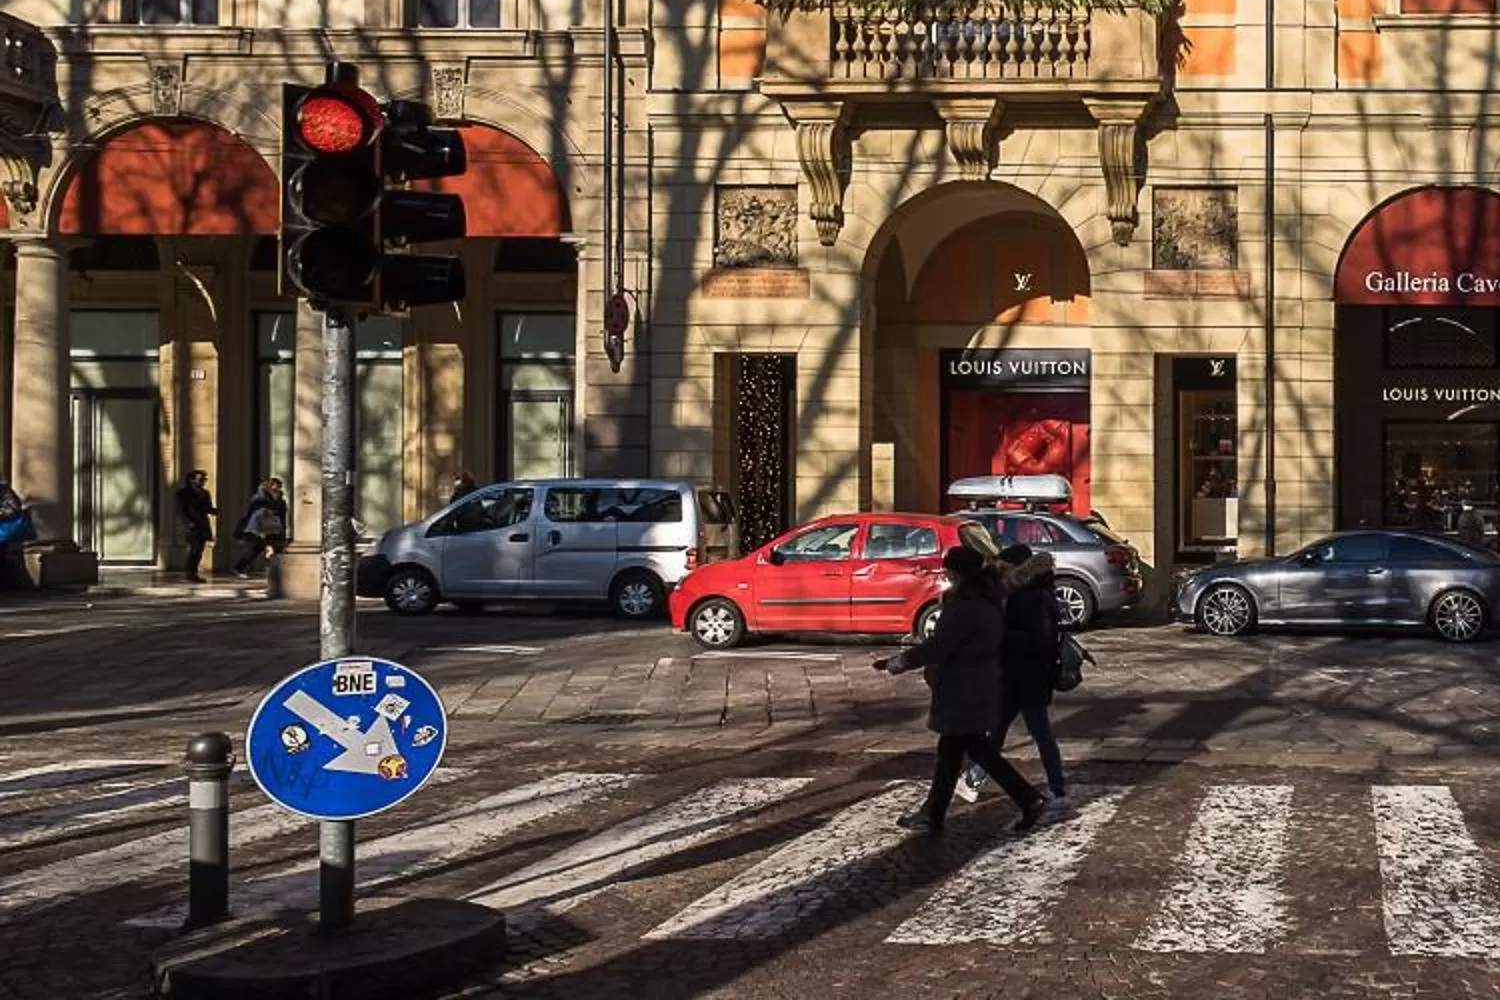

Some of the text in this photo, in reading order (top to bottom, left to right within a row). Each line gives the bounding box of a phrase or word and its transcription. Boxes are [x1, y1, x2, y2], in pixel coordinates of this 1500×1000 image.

[1365, 271, 1450, 293] Galleria
[950, 360, 1086, 375] LOUIS VUITTON
[1383, 387, 1428, 401] LOUIS
[336, 673, 373, 693] BNE
